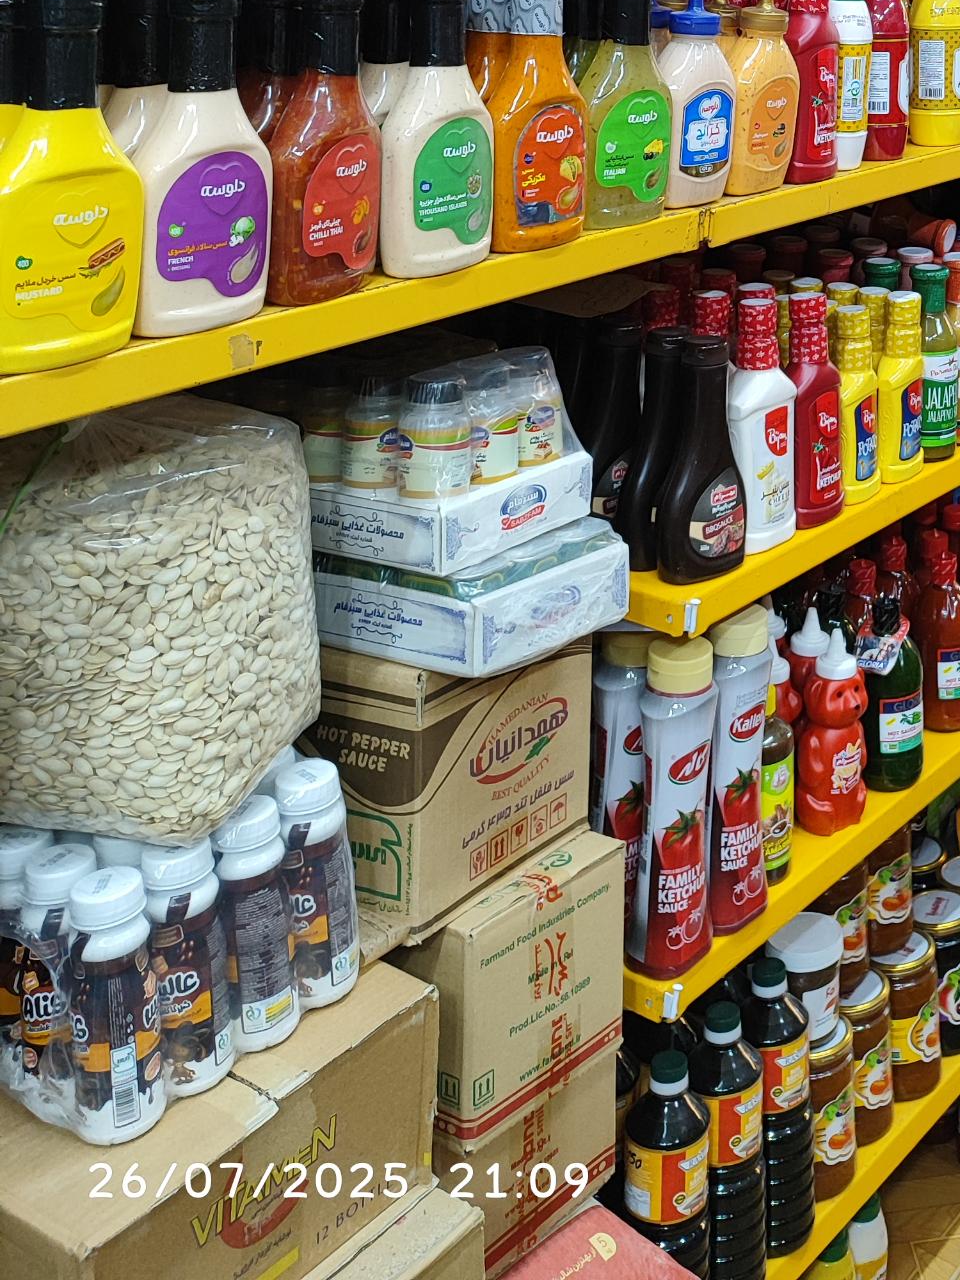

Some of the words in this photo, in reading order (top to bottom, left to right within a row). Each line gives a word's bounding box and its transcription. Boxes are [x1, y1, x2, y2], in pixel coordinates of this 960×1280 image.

[536, 124, 574, 144] دلوسه
[444, 140, 477, 159] دلوسه
[336, 160, 368, 178] دلوسه
[201, 178, 247, 198] دلوسه
[53, 204, 109, 227] دلوسه
[418, 205, 448, 216] THOUSAND
[448, 201, 468, 212] ISLANDS
[309, 229, 330, 241] CHILLI
[329, 225, 344, 236] THAI
[168, 254, 195, 266] FRENCH
[341, 519, 365, 534] غذایی
[366, 523, 405, 540] محصولات
[386, 610, 424, 628] محصولات
[857, 659, 886, 670] GLORIA
[316, 723, 349, 744] HOT
[350, 729, 411, 762] PEPPER
[468, 708, 569, 780] همدانیان
[337, 748, 389, 774] SAUCE
[491, 786, 514, 802] BEST
[512, 753, 552, 794] QUALITY
[553, 769, 575, 791] سس
[529, 780, 553, 806] فلفل
[720, 821, 760, 850] FAMILY
[720, 856, 749, 873] SAUCE
[657, 862, 702, 890] FAMILY
[657, 900, 689, 915] SAUCE
[479, 942, 516, 969] Farmand
[516, 927, 538, 946] Food
[538, 905, 576, 934] Industries
[315, 1226, 330, 1245] 12
